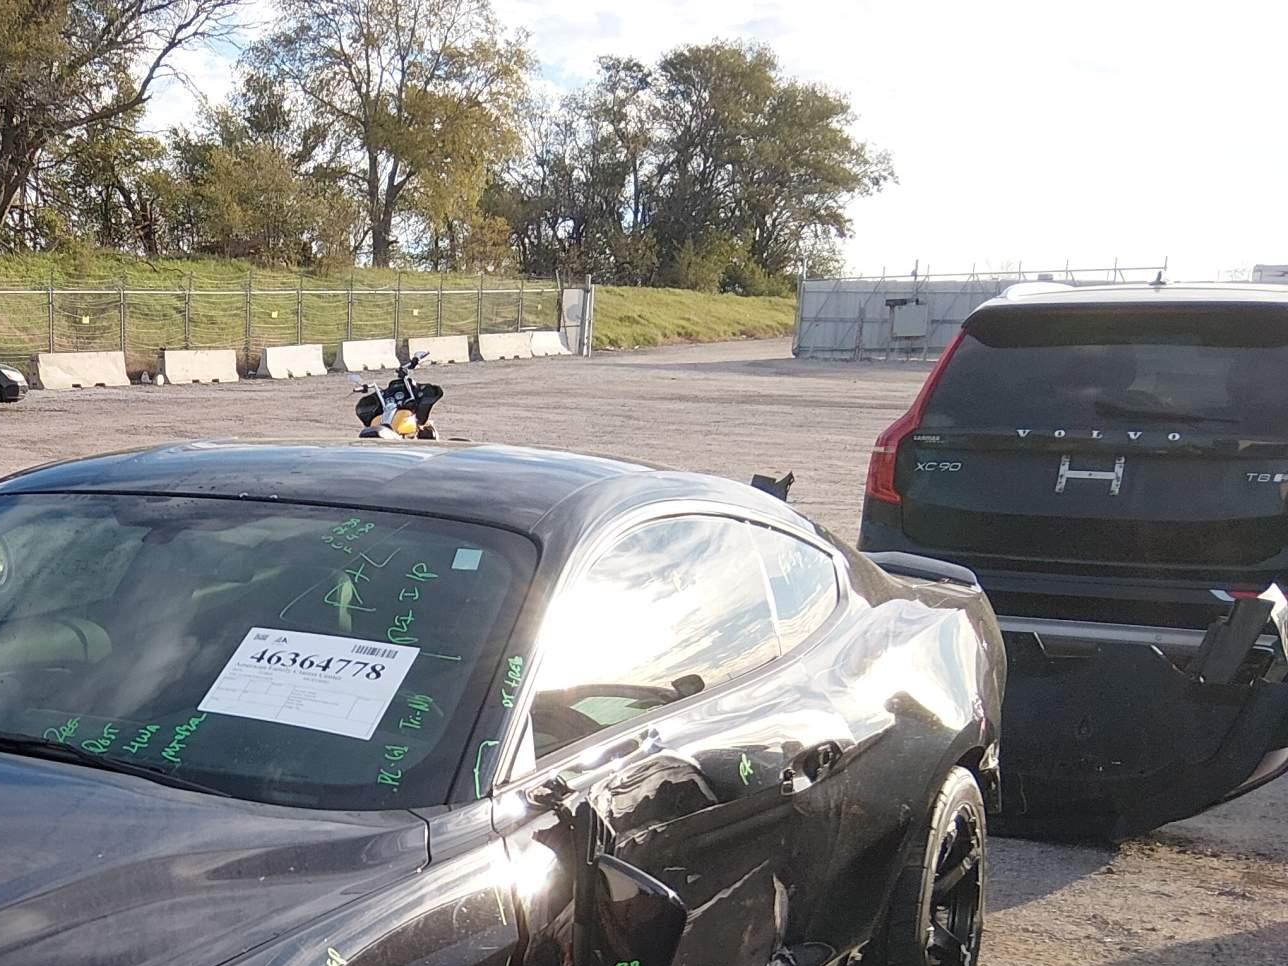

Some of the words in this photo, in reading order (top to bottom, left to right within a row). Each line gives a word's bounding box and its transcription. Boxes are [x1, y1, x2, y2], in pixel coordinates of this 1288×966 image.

[1015, 428, 1182, 442] VOLVO
[914, 462, 963, 472] XC90
[249, 648, 386, 681] 46364778
